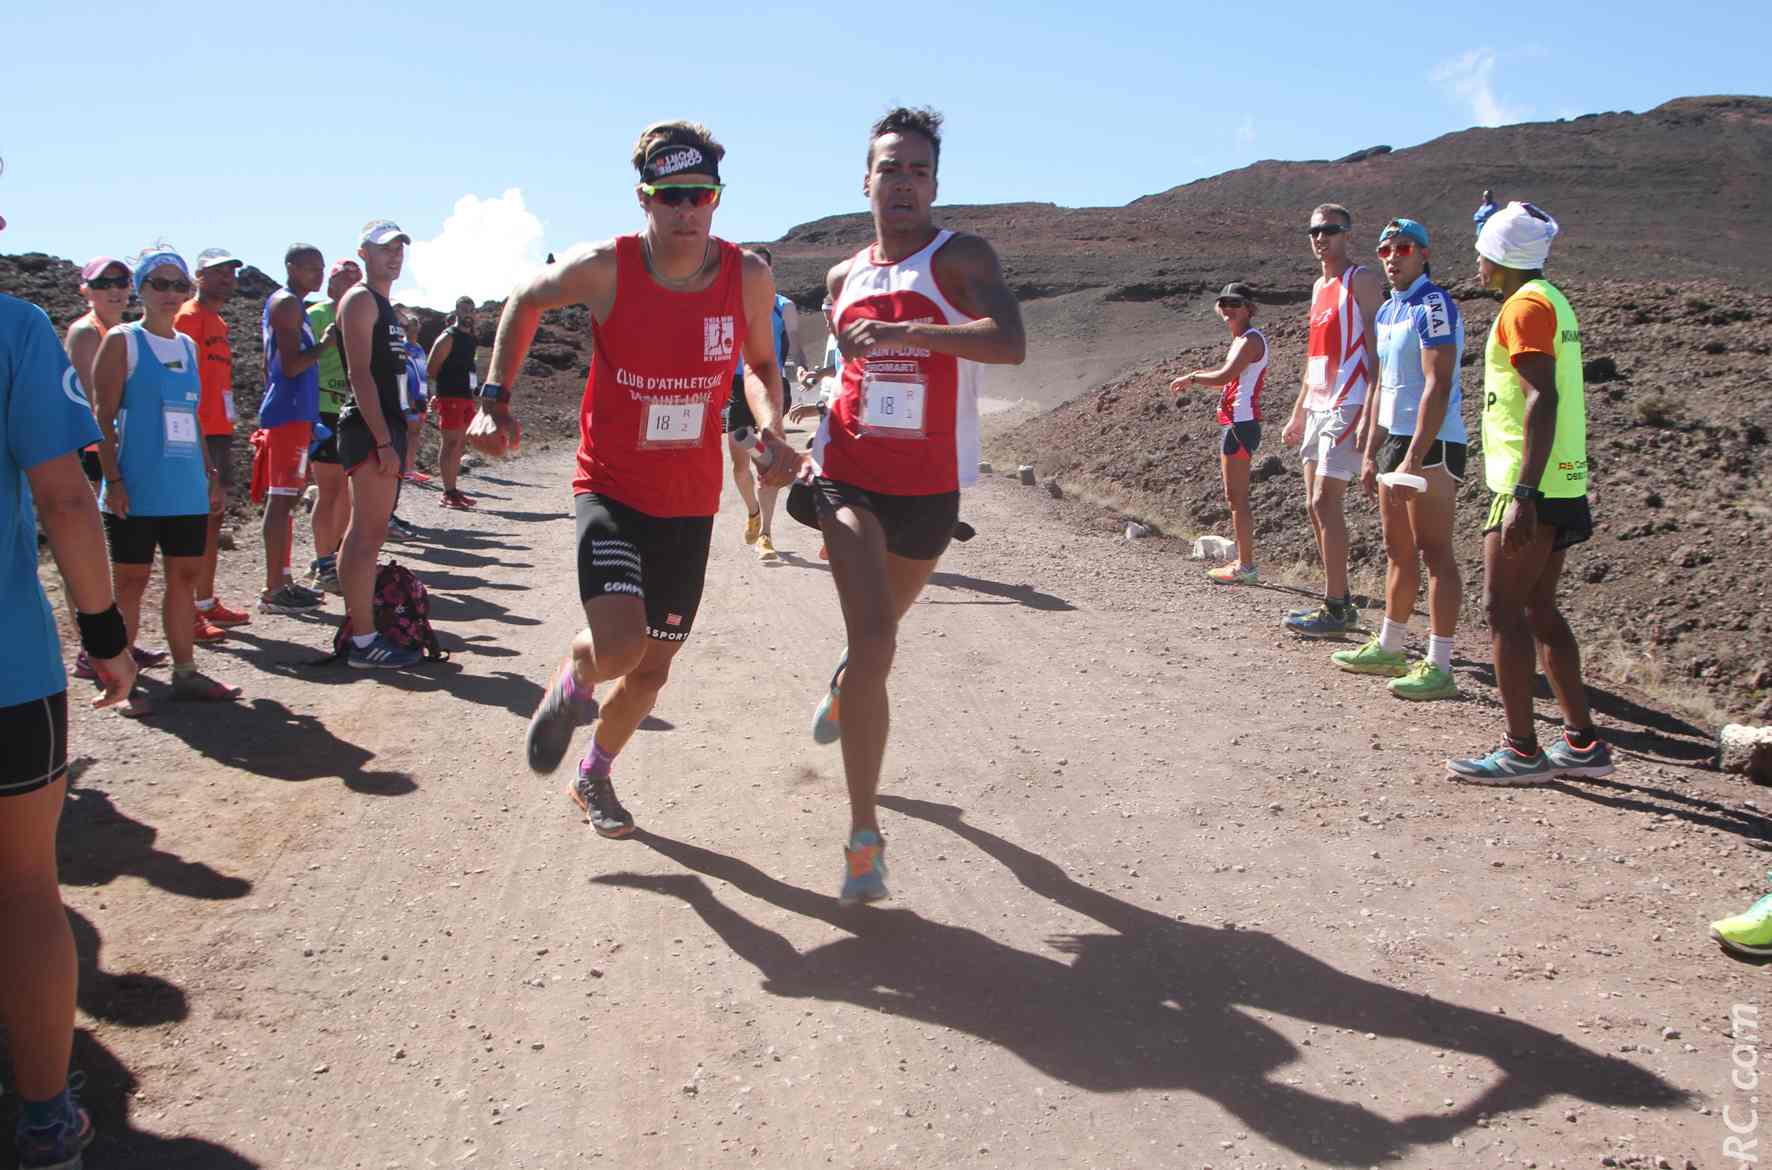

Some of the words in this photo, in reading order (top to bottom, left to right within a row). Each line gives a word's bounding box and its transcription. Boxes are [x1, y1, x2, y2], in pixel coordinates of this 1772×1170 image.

[617, 368, 644, 388] CLUB
[881, 396, 895, 415] 18
[656, 415, 671, 431] 18
